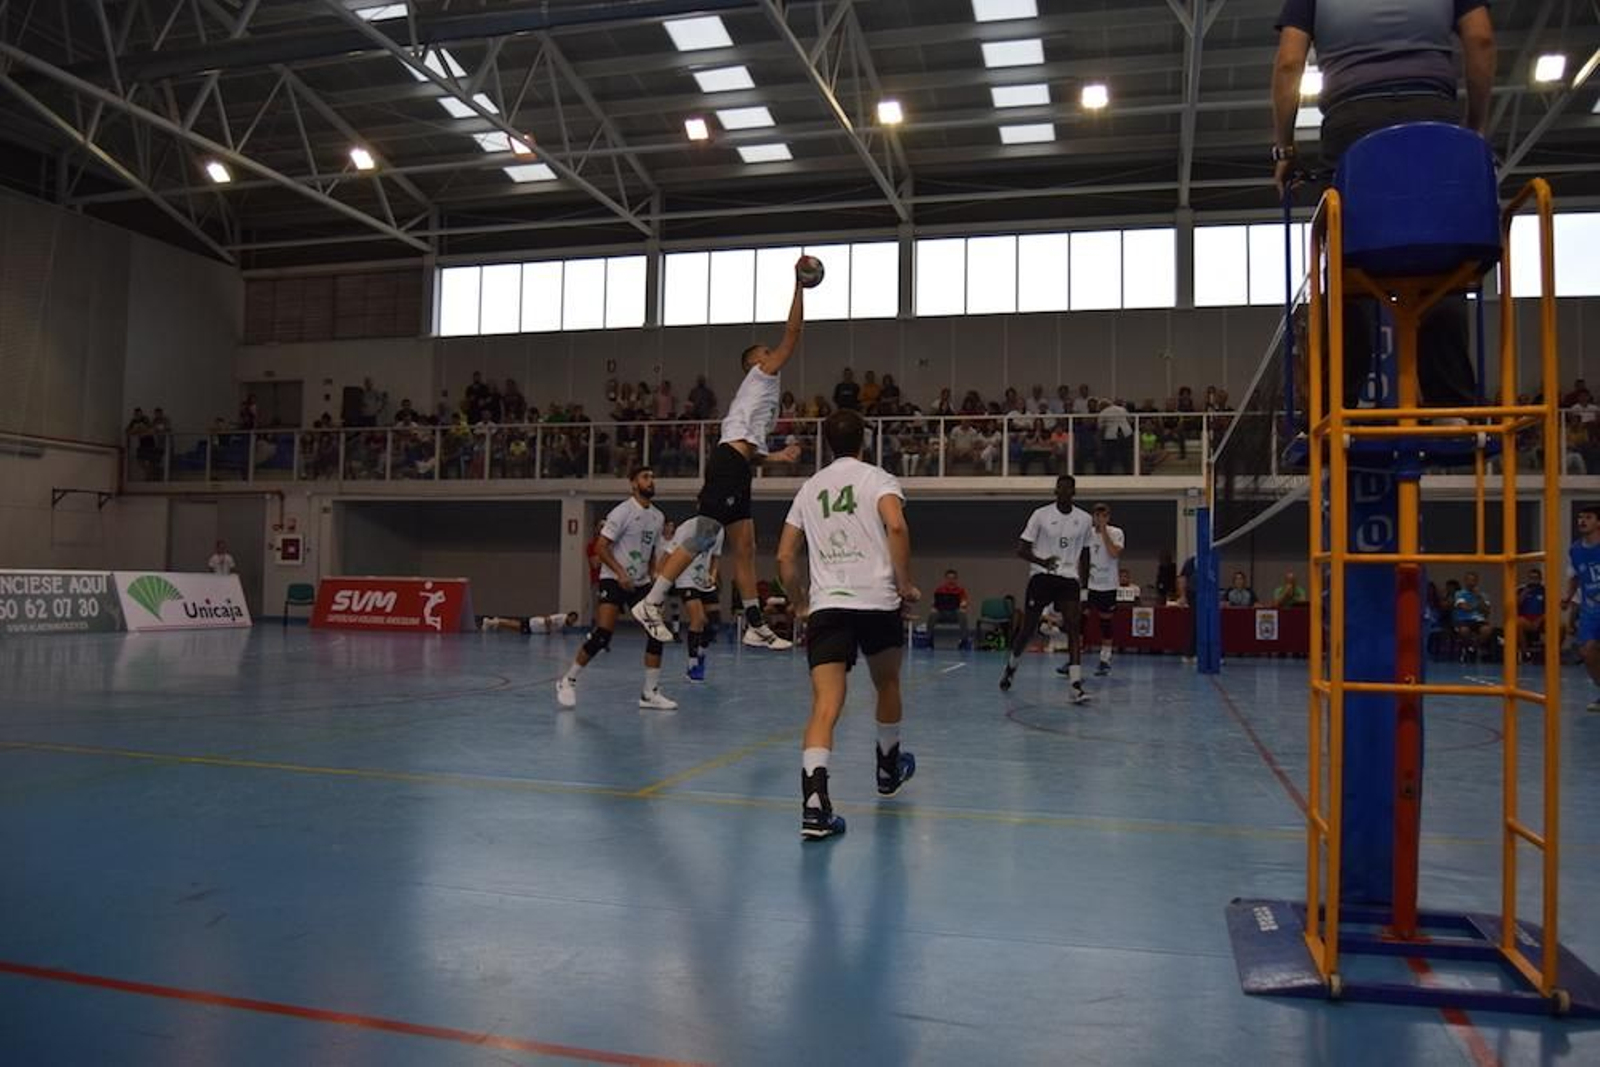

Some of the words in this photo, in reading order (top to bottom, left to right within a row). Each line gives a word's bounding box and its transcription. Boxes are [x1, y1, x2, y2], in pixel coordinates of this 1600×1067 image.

[817, 484, 858, 519] 14
[642, 530, 654, 545] 15
[1060, 536, 1068, 549] 6
[25, 598, 48, 619] 62
[53, 598, 72, 618] 07
[78, 598, 99, 617] 30
[183, 598, 243, 621] Unicaja
[331, 589, 397, 612] SVM
